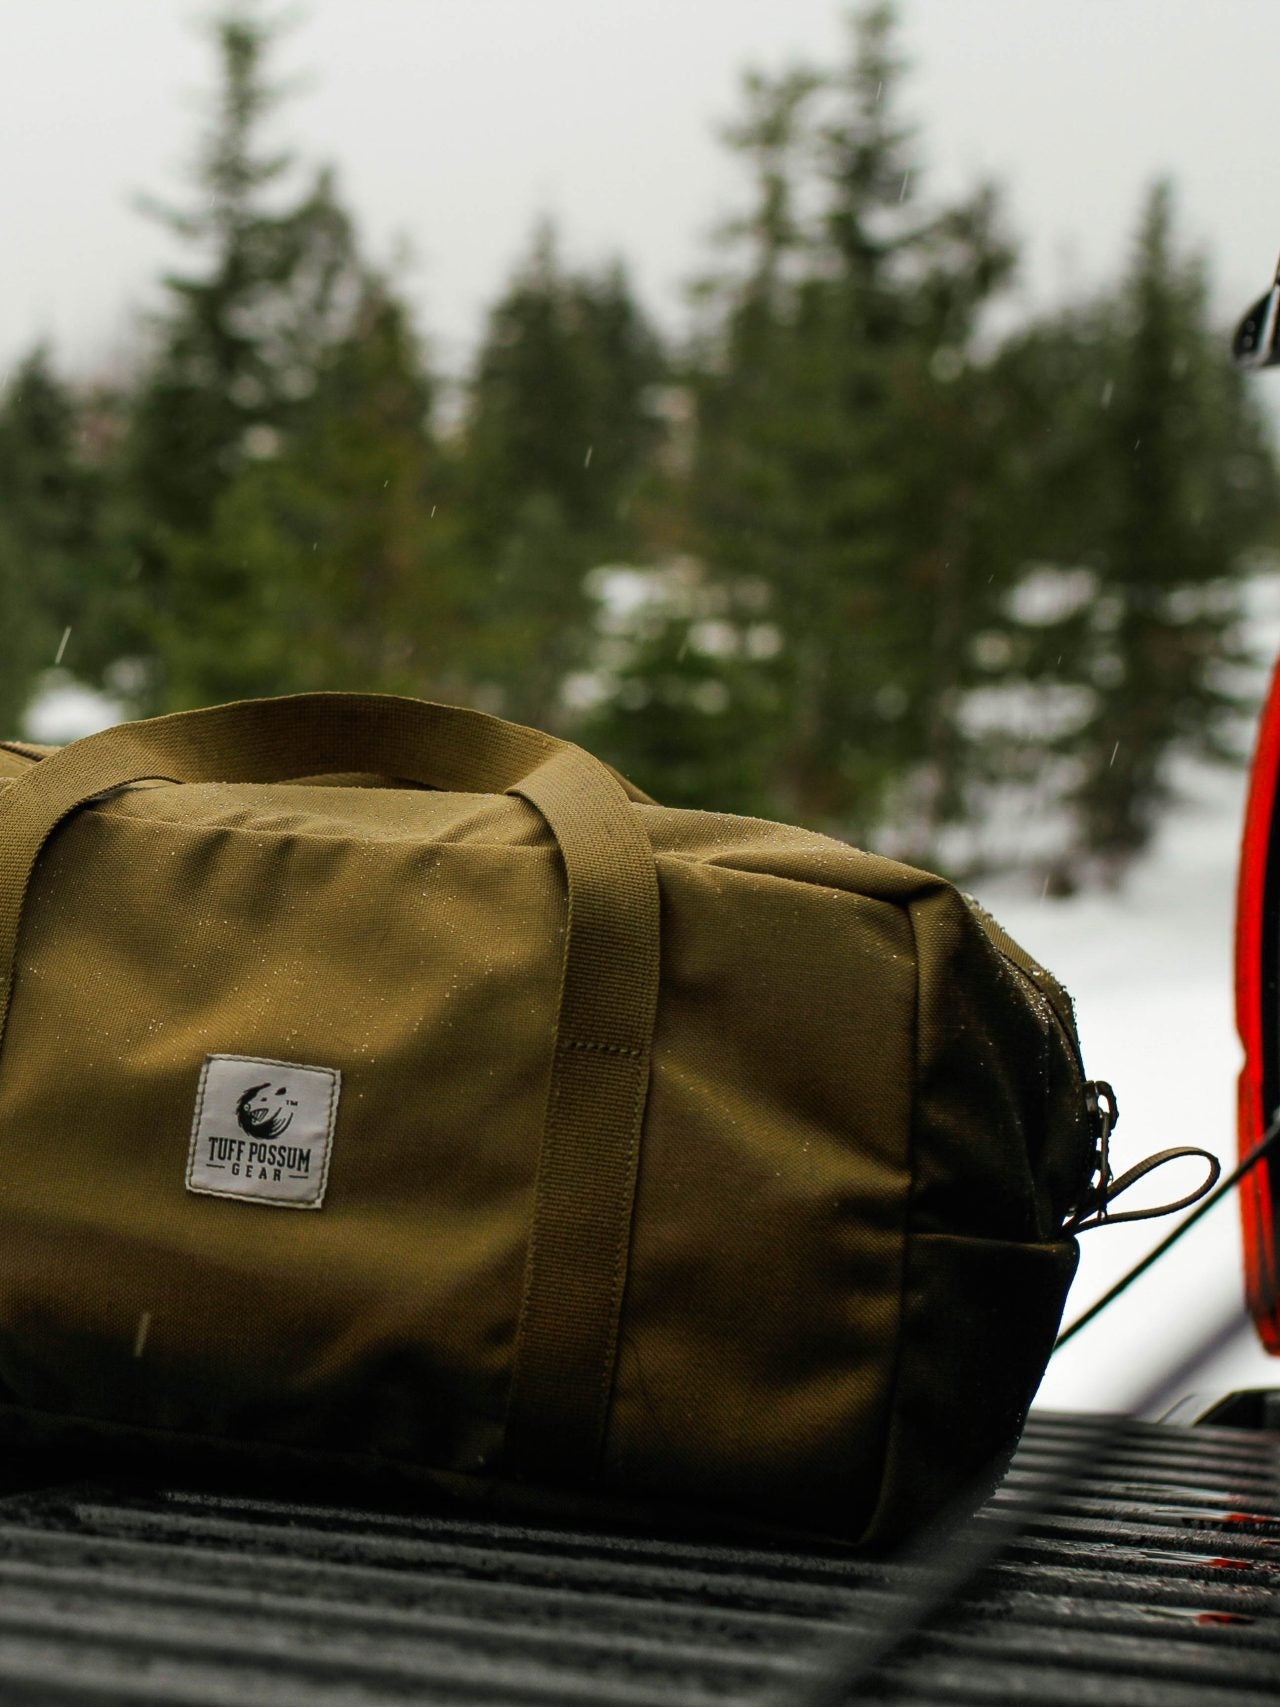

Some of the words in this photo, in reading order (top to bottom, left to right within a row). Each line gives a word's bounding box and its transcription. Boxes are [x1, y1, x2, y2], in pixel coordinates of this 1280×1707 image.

[208, 1137, 245, 1162] TUFF
[248, 1142, 311, 1173] POSSUM
[231, 1164, 282, 1181] GEAR
